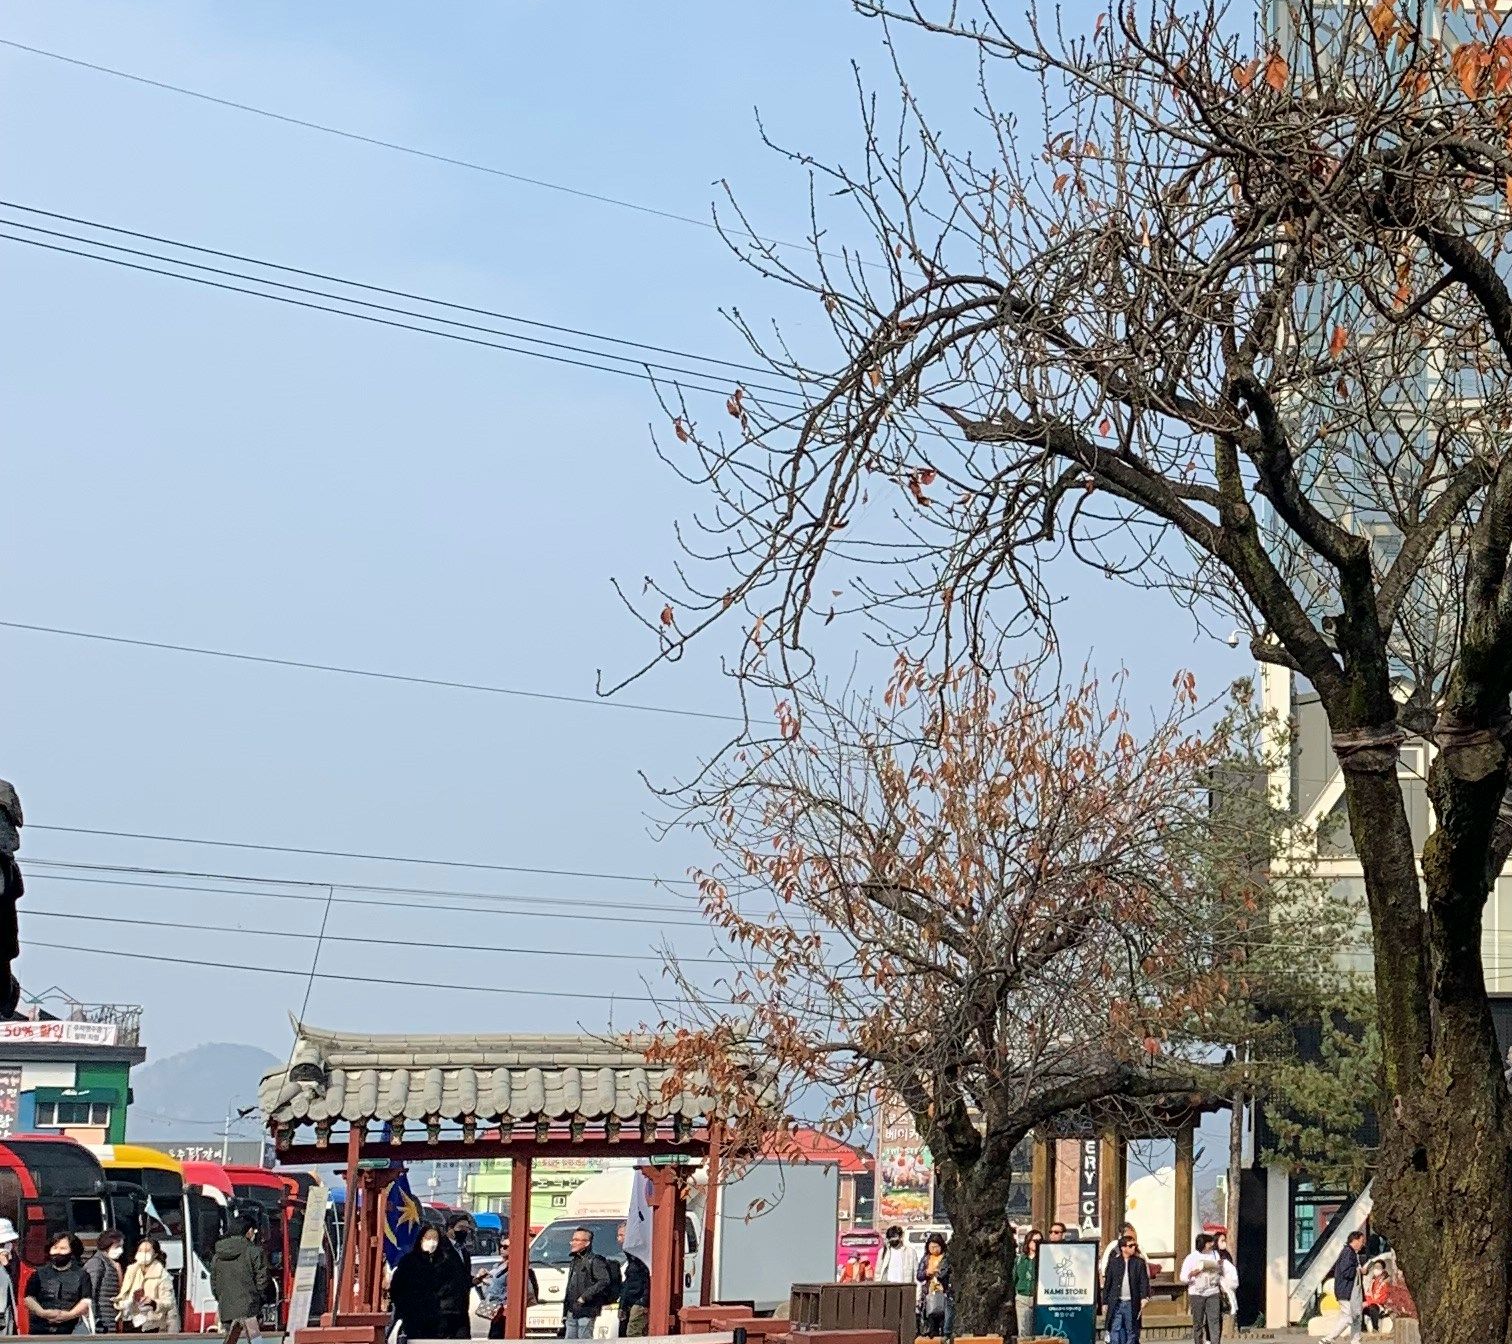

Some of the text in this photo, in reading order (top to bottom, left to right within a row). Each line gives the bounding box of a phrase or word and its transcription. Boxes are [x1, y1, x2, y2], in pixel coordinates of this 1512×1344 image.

[4, 1024, 64, 1038] 50% 할인
[885, 1128, 922, 1142] 베이커
